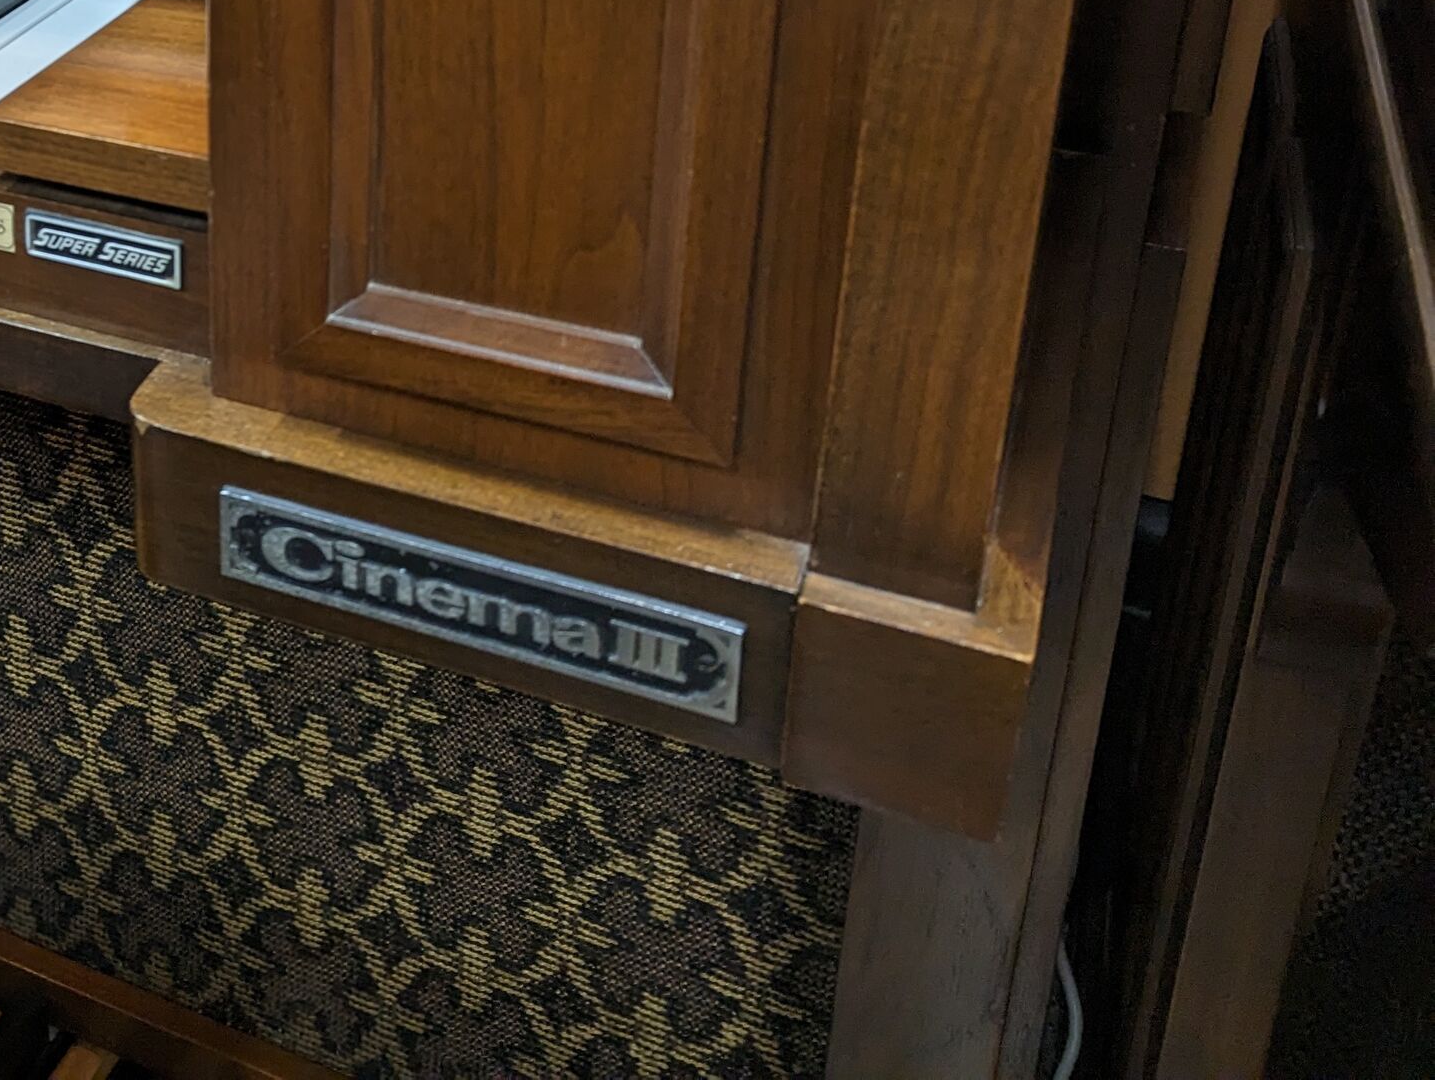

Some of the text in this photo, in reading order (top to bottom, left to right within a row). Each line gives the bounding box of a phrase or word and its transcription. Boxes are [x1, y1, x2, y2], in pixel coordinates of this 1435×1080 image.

[33, 226, 173, 276] SUPER SERIES
[261, 524, 693, 685] Cinema III
